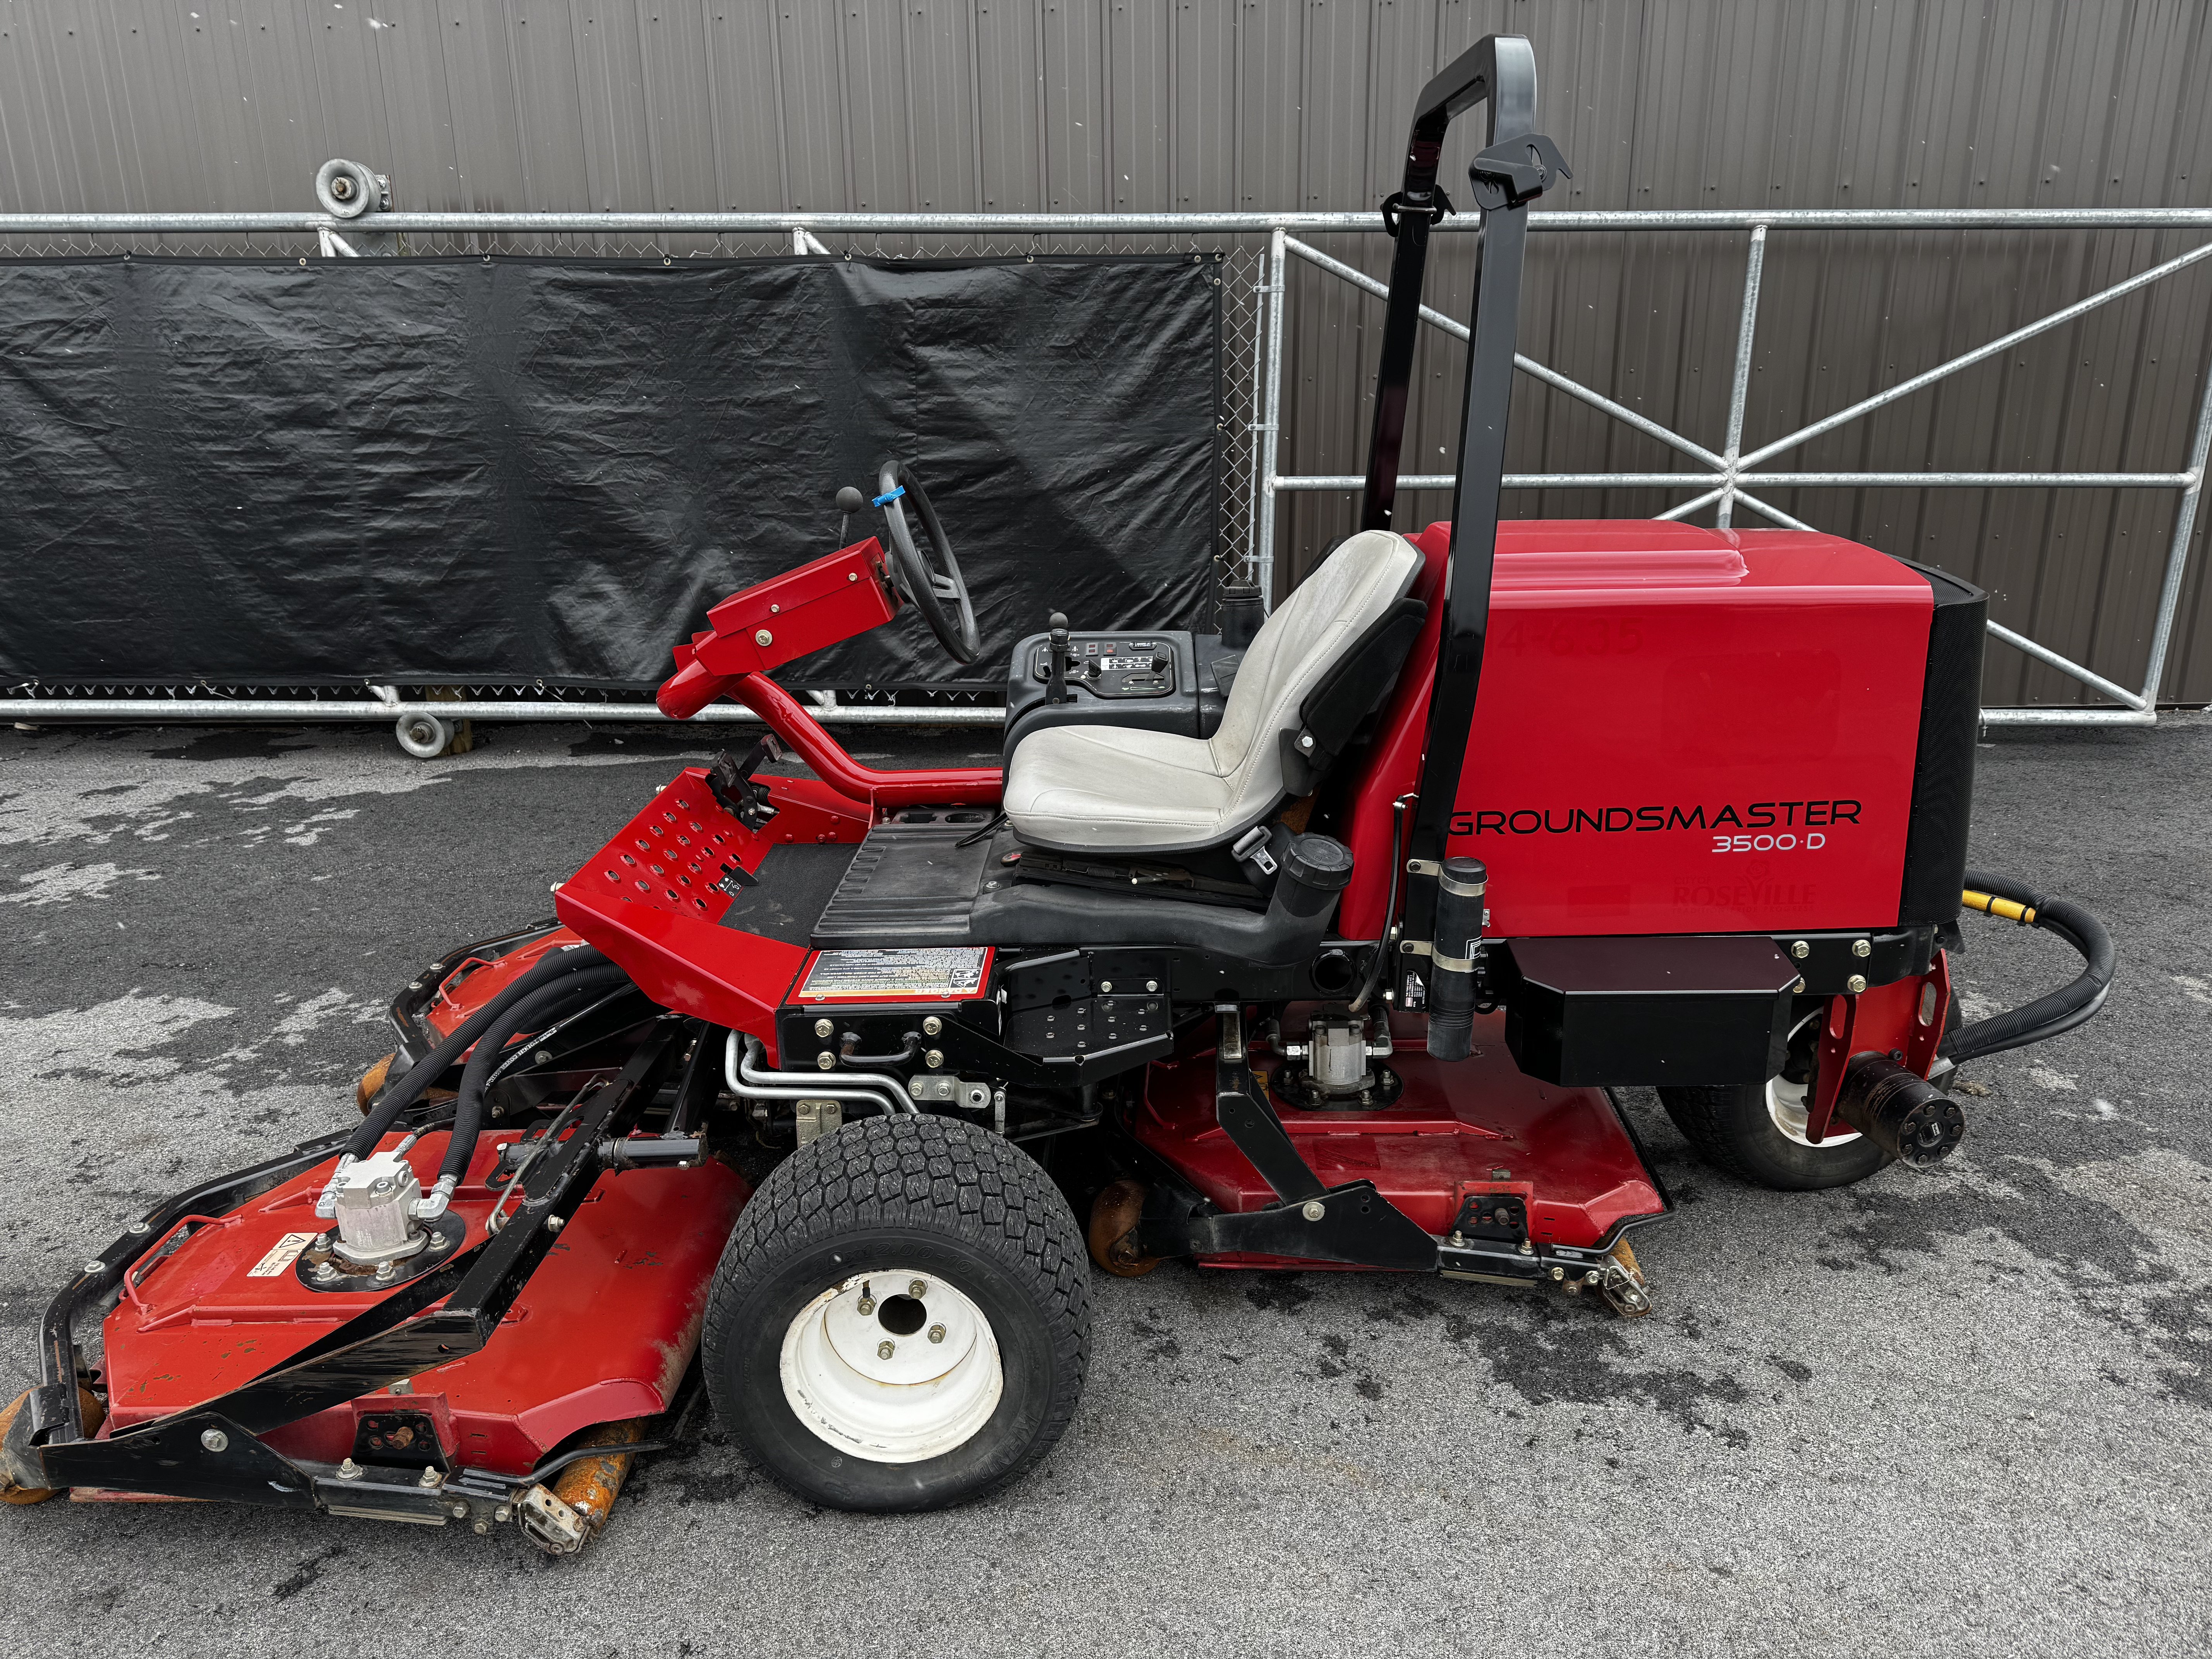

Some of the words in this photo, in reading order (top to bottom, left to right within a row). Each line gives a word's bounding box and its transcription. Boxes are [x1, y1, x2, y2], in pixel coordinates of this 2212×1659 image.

[1449, 800, 1862, 836] GROUNDSMASTER
[1673, 883, 1817, 907] ROSEVILLE
[953, 1411, 1041, 1494] KENDA
